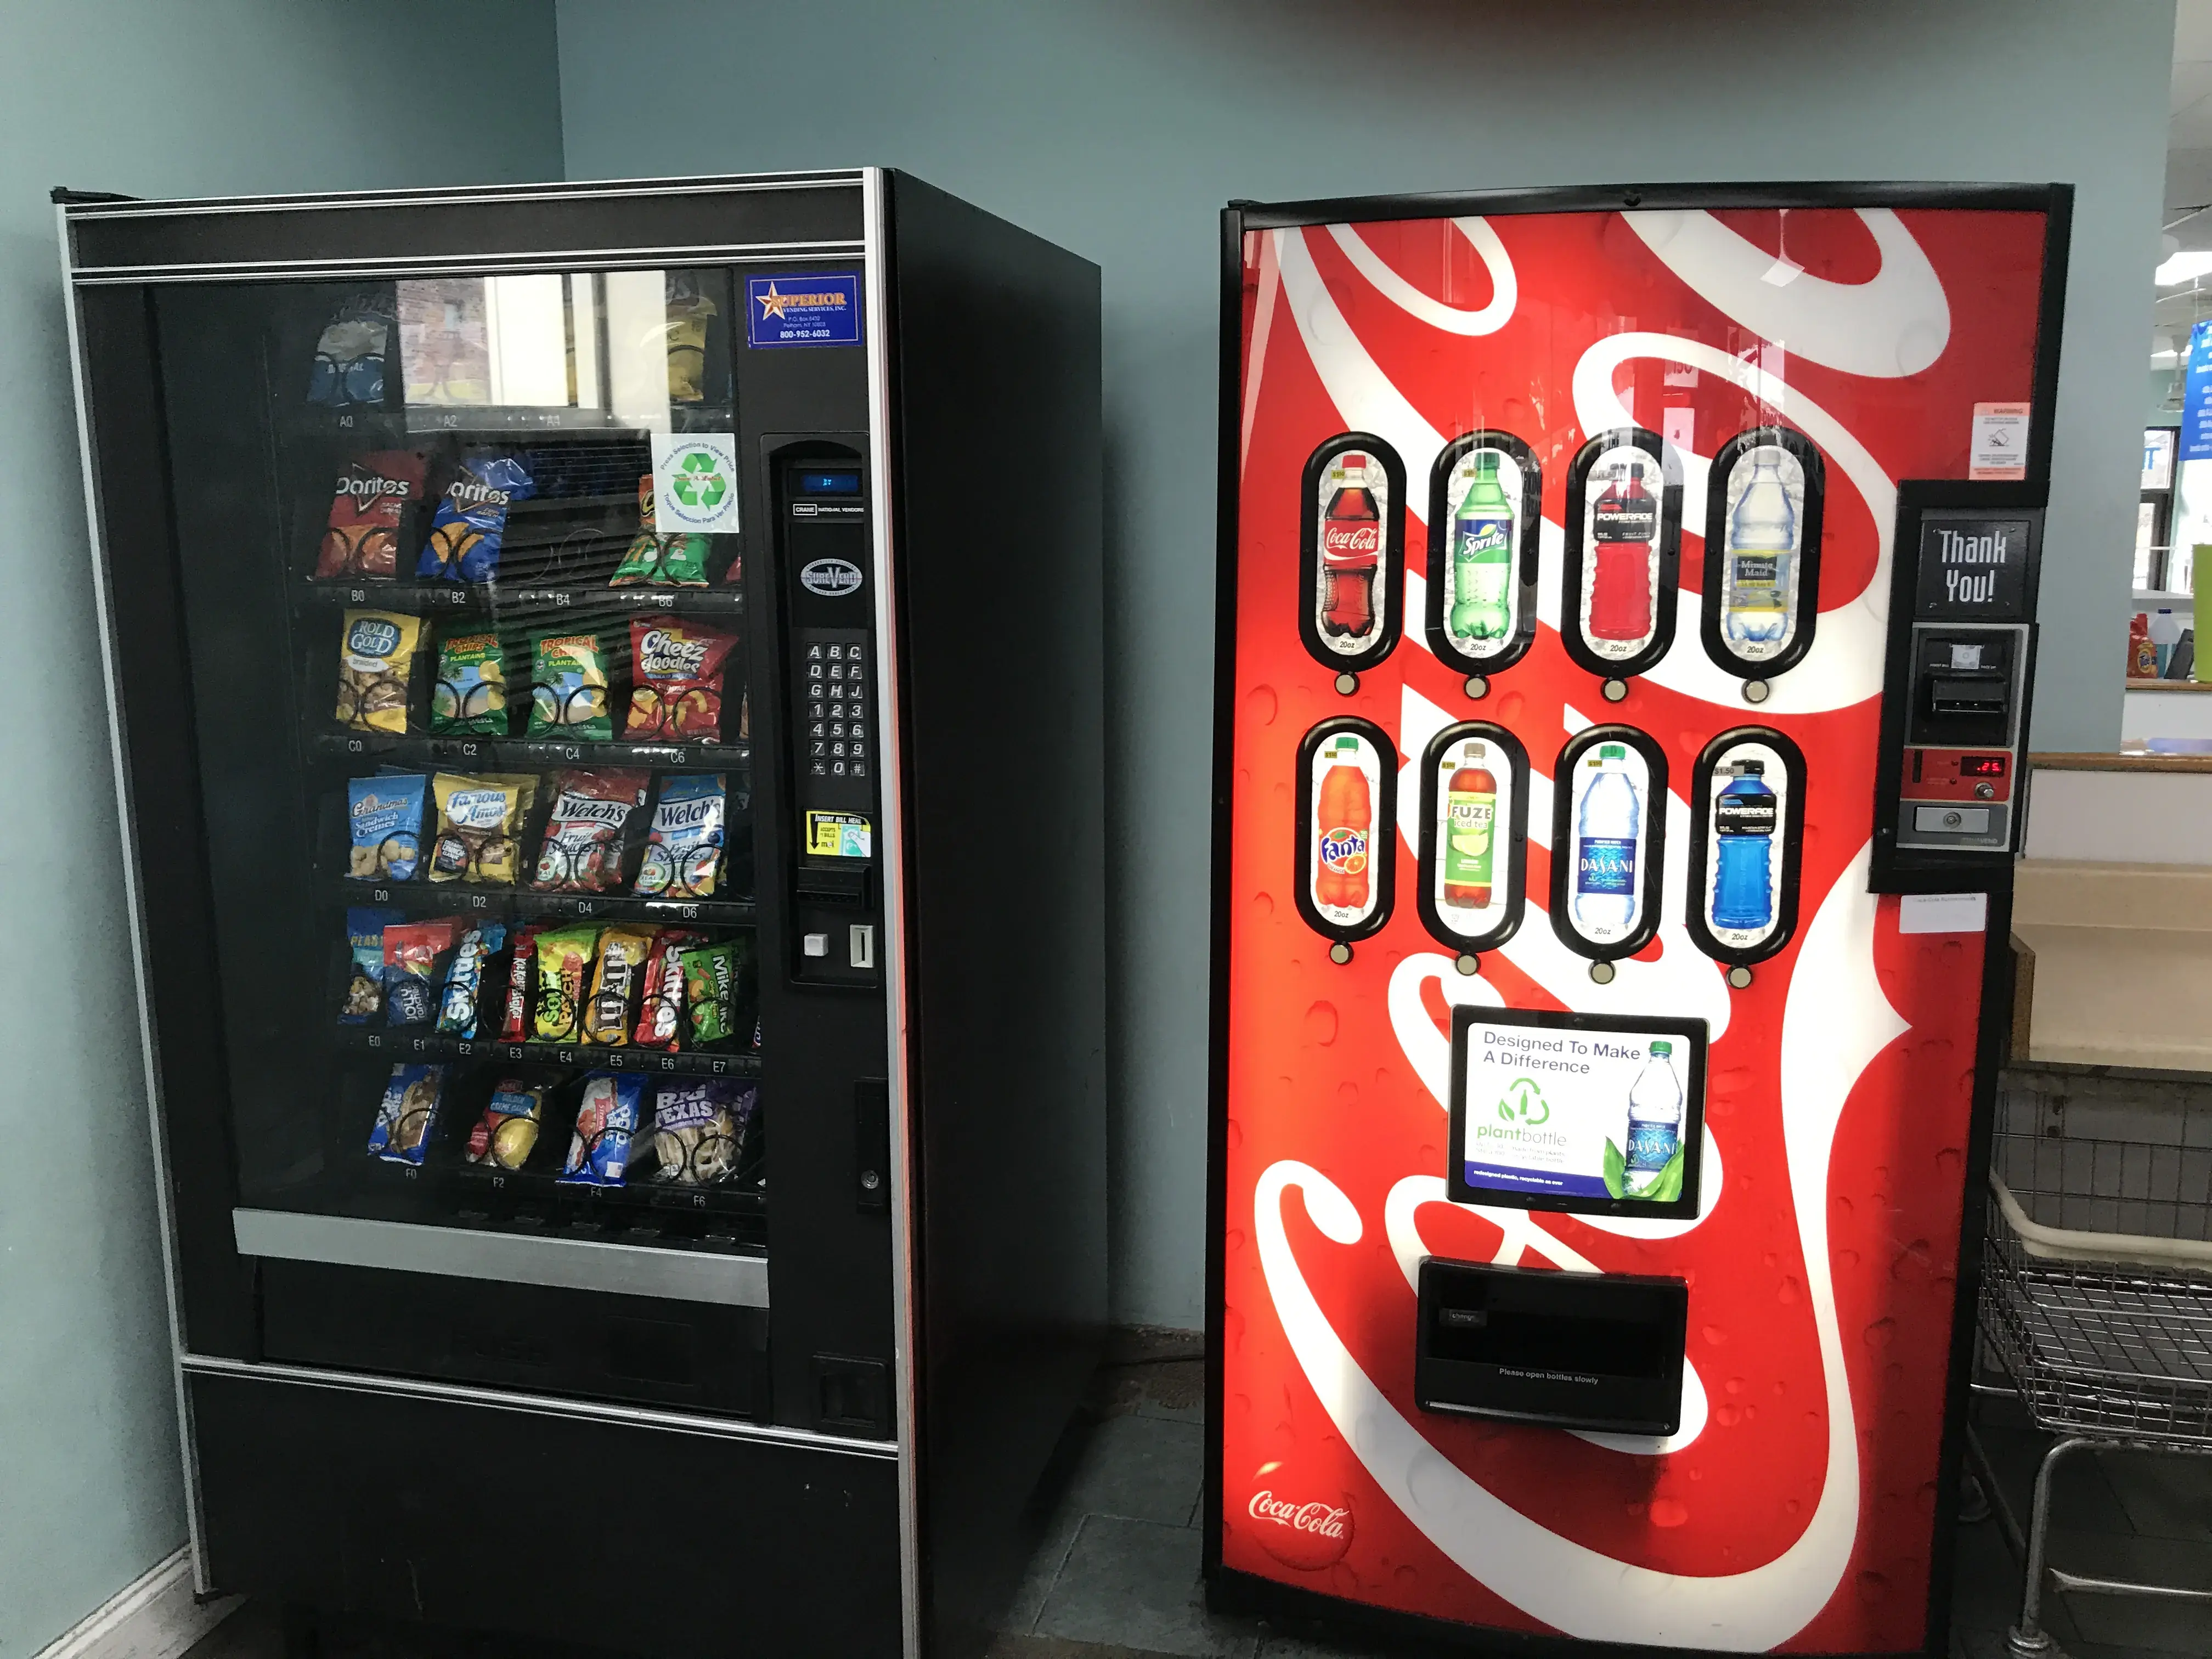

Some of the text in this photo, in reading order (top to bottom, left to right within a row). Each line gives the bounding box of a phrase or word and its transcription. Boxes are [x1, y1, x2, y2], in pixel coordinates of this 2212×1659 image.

[771, 292, 847, 307] SUPERIOR
[780, 330, 831, 338] 800-952-6032
[443, 415, 458, 427] A2
[660, 454, 674, 470] Press
[673, 442, 701, 454] Selection
[710, 445, 724, 457] View
[723, 455, 735, 472] Price
[336, 476, 410, 495] Doritos
[664, 493, 675, 511] Toque
[675, 509, 702, 524] Seleccion
[702, 516, 716, 524] Para
[715, 510, 725, 518] Ver
[723, 493, 735, 511] Precio
[1597, 512, 1652, 521] POWERADE
[1326, 527, 1377, 550] Coca-Cola
[1463, 531, 1504, 555] Sprite
[1939, 529, 2007, 564] Thank
[1740, 560, 1773, 569] Minute
[1745, 567, 1768, 577] Maid
[1946, 569, 1995, 603] You!
[351, 590, 365, 602] B0
[452, 591, 466, 604] B2
[556, 594, 570, 606] B4
[658, 596, 673, 607] B6
[358, 620, 396, 638] ROLD
[351, 633, 393, 653] GOLD
[454, 642, 486, 654] CHIPS
[540, 634, 600, 657] TROPICAL
[640, 630, 709, 662] Cheez
[1339, 640, 1355, 649] 20oz
[1470, 643, 1487, 652] 20oz
[1609, 644, 1627, 652] 20oz
[810, 646, 859, 657] A B C
[1746, 645, 1764, 654] 20oz
[450, 652, 486, 662] PLANTAINS
[641, 656, 701, 674] doodles
[811, 665, 860, 677] D E F
[811, 685, 860, 697] G H J
[814, 704, 861, 716] 1 2 3
[813, 723, 862, 735] 4 5 6
[463, 744, 477, 755] C2
[566, 748, 580, 760] C4
[815, 742, 862, 755] 7 8 9
[670, 751, 685, 763] C6
[456, 805, 504, 825] Amos
[561, 799, 627, 821] Welch's
[1452, 806, 1491, 819] FUZE
[356, 811, 398, 828] Sandwich
[815, 814, 834, 822] INSERT
[1454, 819, 1472, 827] iced
[356, 821, 395, 837] Cremes
[560, 831, 592, 844] Fruit
[1321, 835, 1365, 864] Fanta
[1581, 855, 1633, 874] DASANI
[375, 890, 388, 901] D0
[473, 896, 487, 908] D2
[578, 902, 592, 913] D4
[683, 907, 697, 918] D6
[1334, 910, 1349, 918] 20oz
[1731, 933, 1748, 941] 20oz
[446, 929, 482, 1021] Skittles
[713, 955, 730, 1001] Mike
[369, 1035, 380, 1047] E0
[414, 1039, 424, 1051] E1
[1483, 1030, 1640, 1060] Designed To Make
[459, 1043, 471, 1054] E2
[510, 1047, 522, 1059] E3
[560, 1051, 572, 1063] E4
[610, 1056, 623, 1067] E5
[1483, 1050, 1590, 1074] A Difference
[662, 1058, 674, 1070] E6
[713, 1062, 726, 1073] E7
[654, 1101, 714, 1128] TEXAS
[1628, 1138, 1675, 1155] DASANI
[1474, 1170, 1501, 1178] redesigned
[1499, 1368, 1599, 1385] Please open bottles slowly
[1248, 1490, 1350, 1539] Coca-Cola
